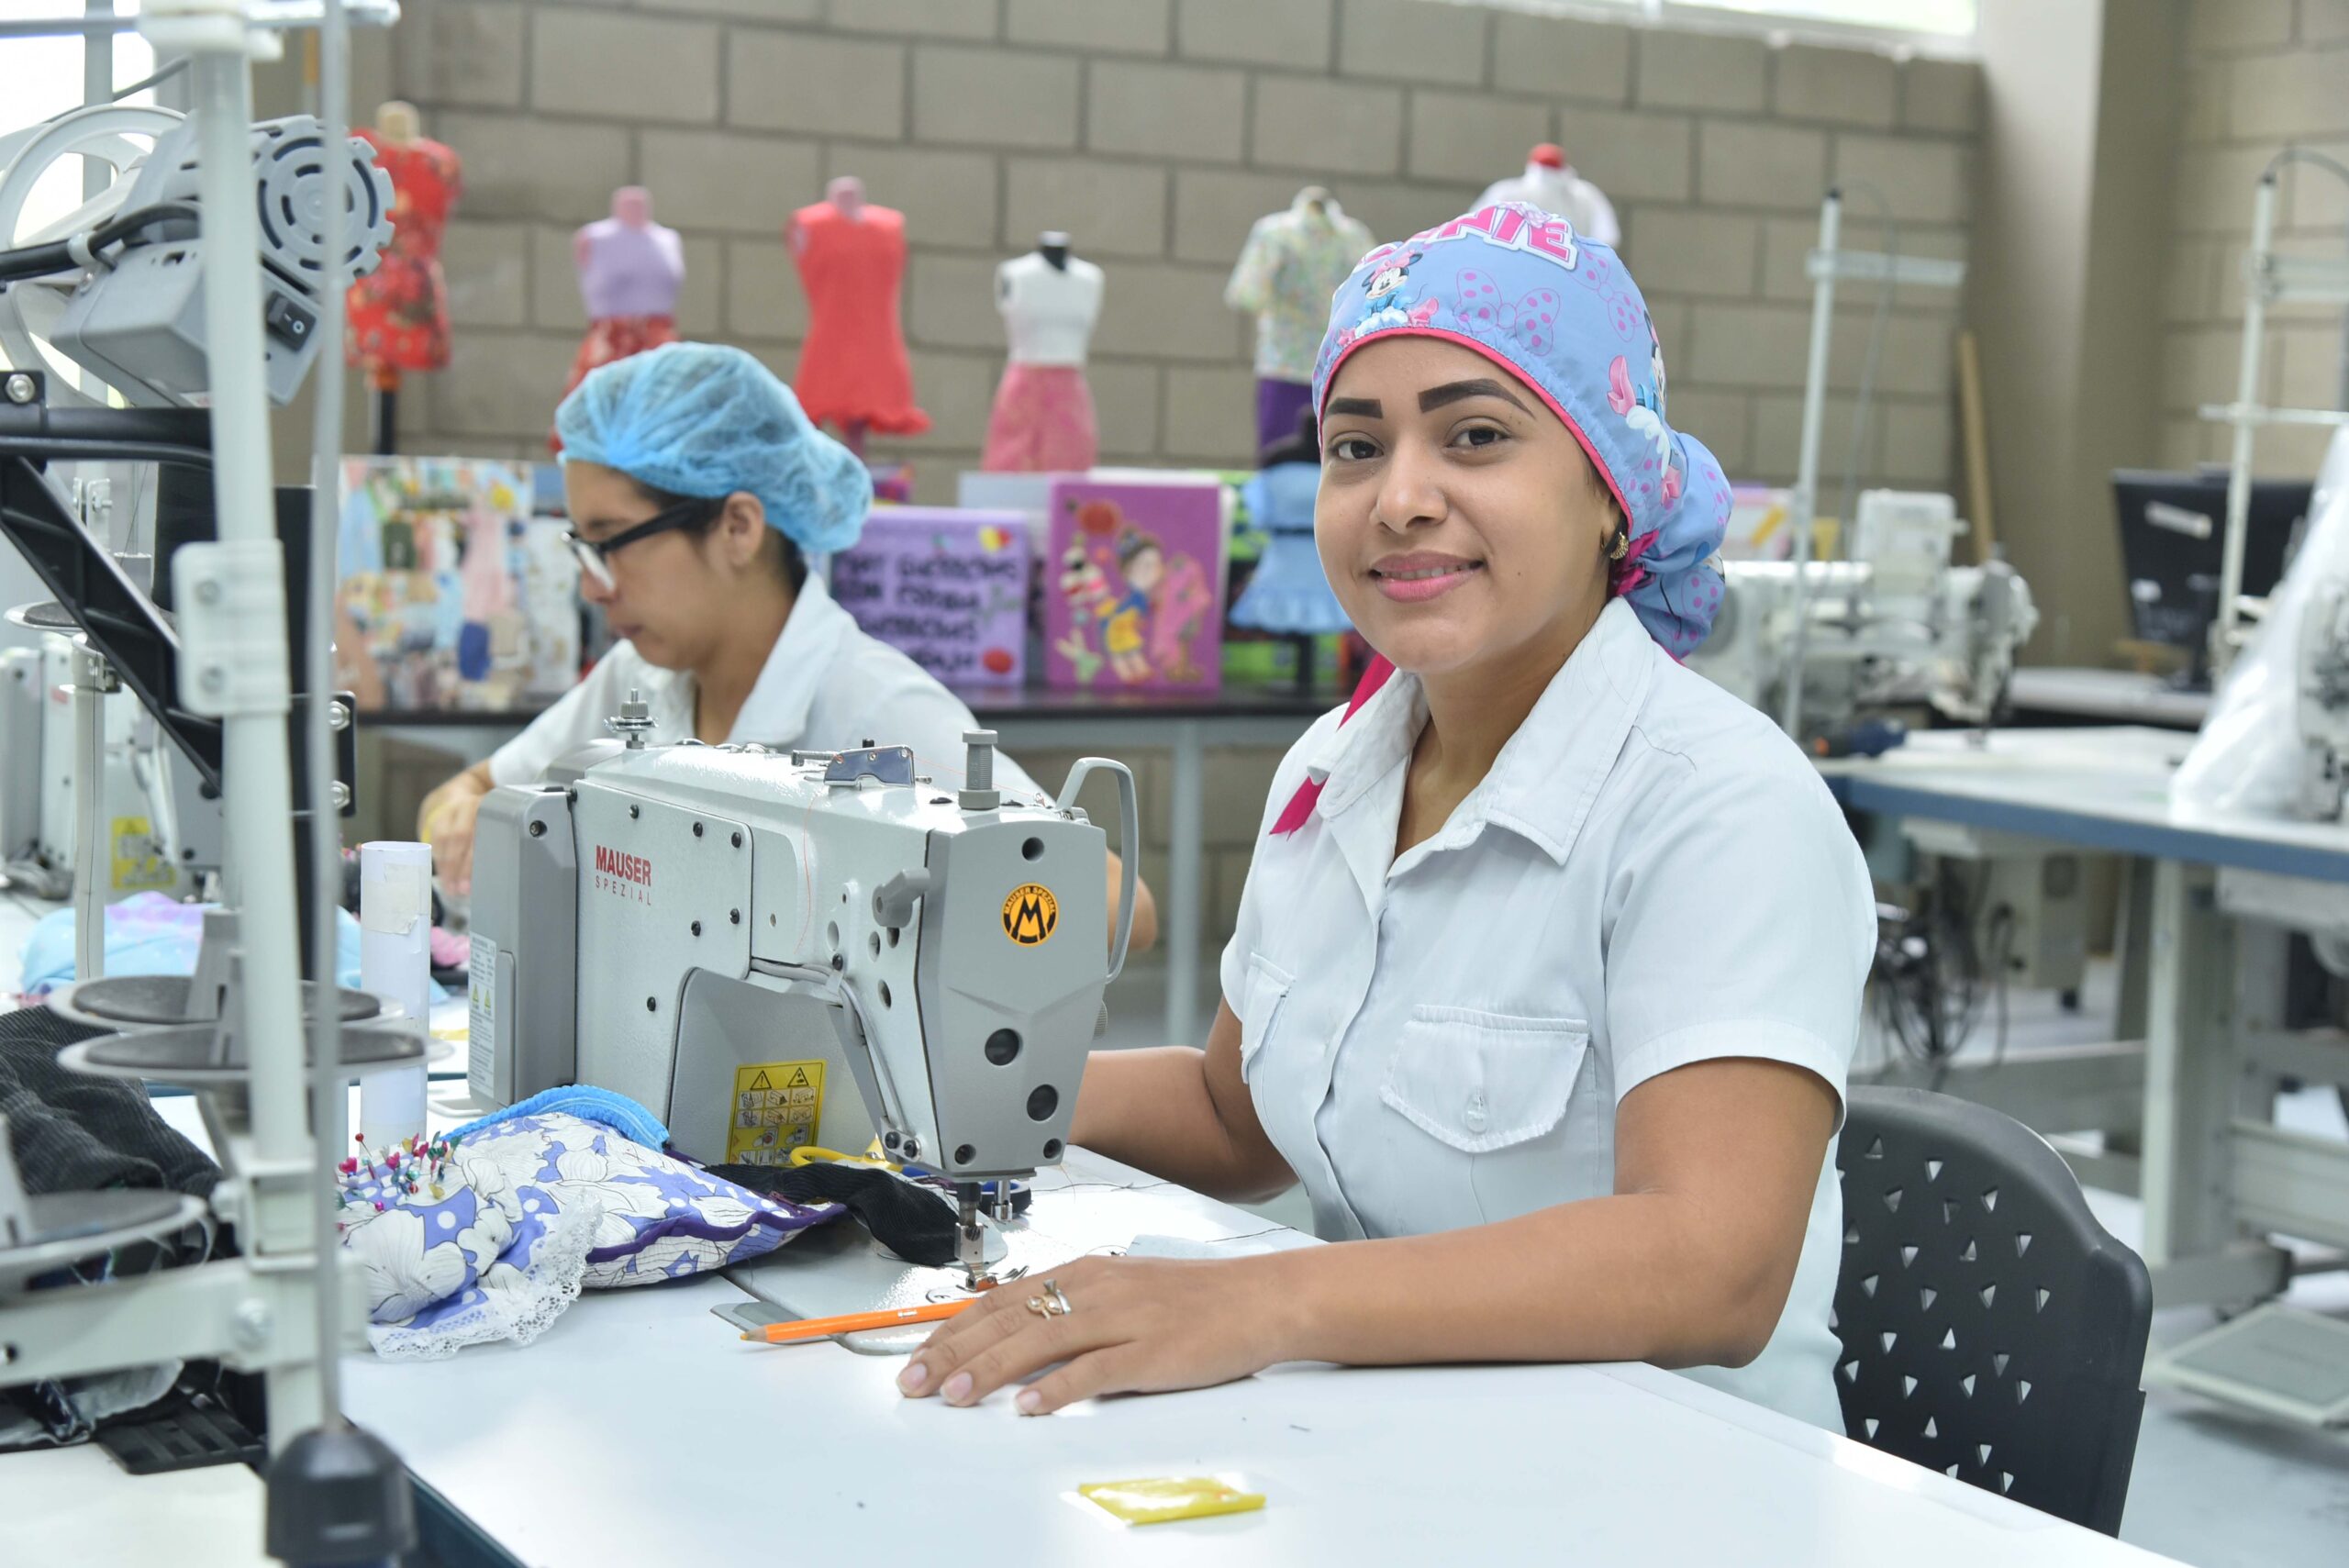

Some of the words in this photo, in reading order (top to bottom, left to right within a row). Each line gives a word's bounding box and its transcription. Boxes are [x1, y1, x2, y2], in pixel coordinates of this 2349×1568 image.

[596, 844, 651, 887] MAUSER
[596, 874, 651, 906] SPEZIAL
[1004, 886, 1031, 914] MAUSER
